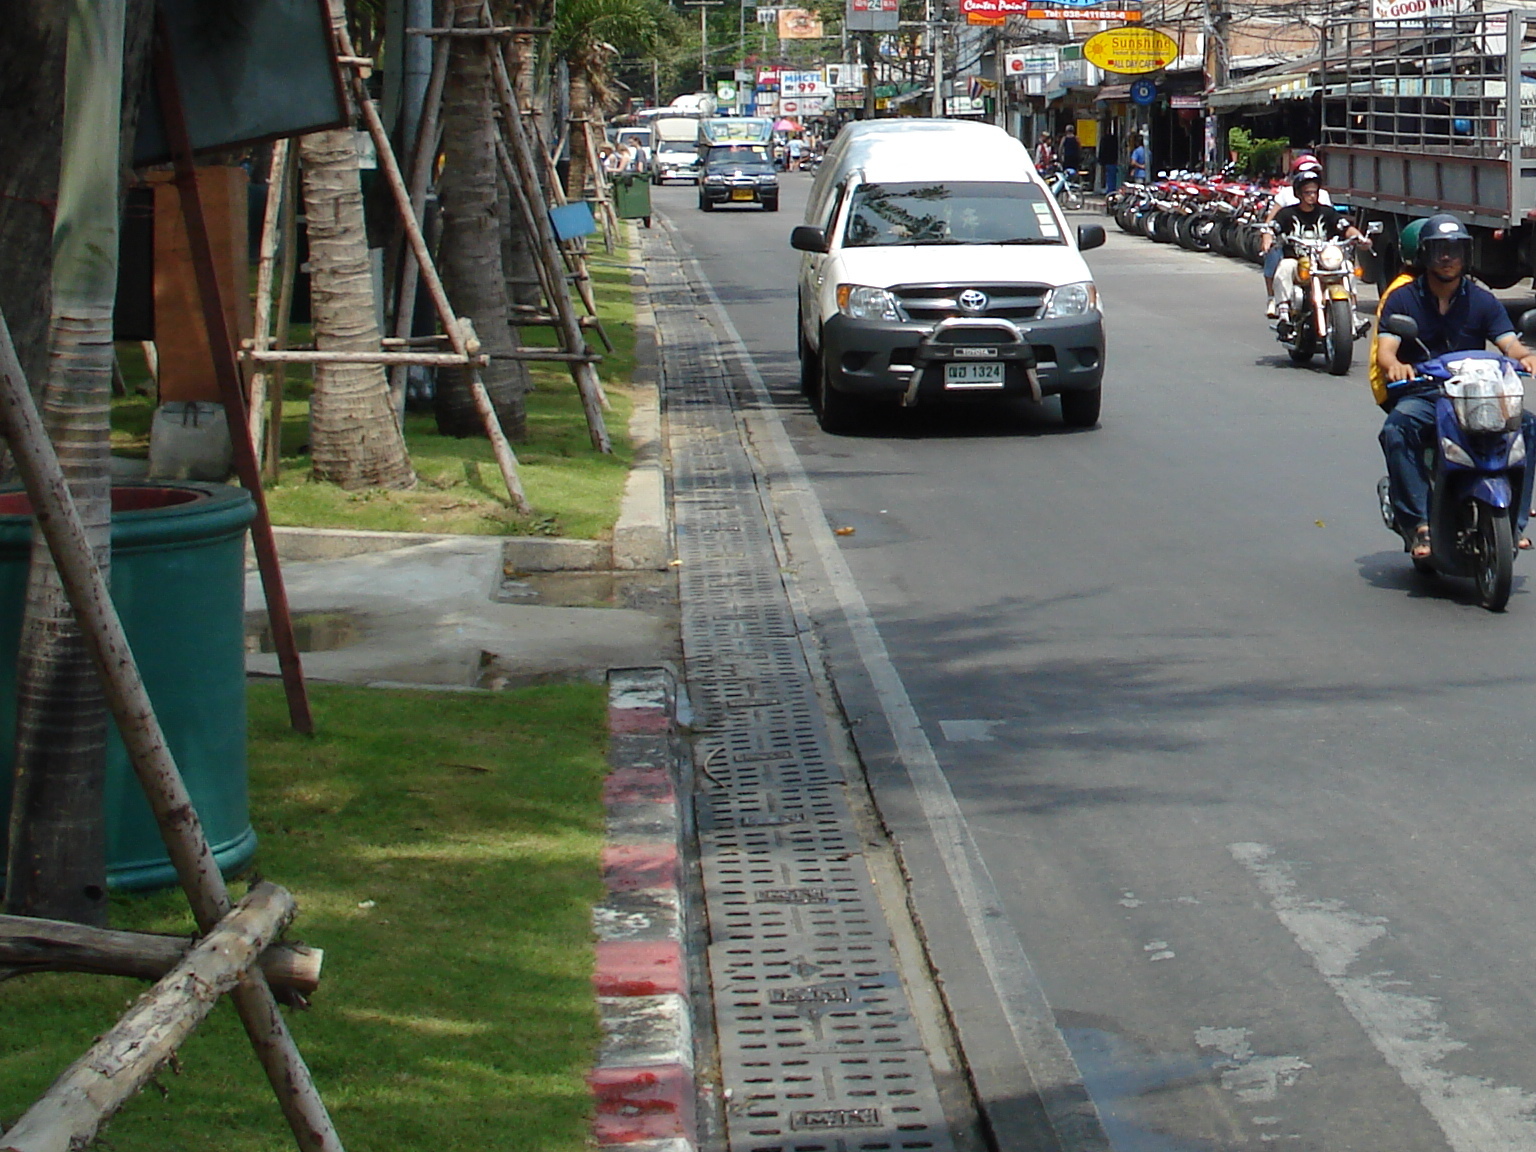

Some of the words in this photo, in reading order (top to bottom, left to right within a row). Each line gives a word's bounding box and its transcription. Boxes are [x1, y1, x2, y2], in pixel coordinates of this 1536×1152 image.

[868, 0, 881, 9] 24
[1390, 0, 1427, 17] GOOD
[1112, 37, 1170, 49] Sunshine
[798, 83, 816, 92] 99
[973, 365, 1000, 378] 1324
